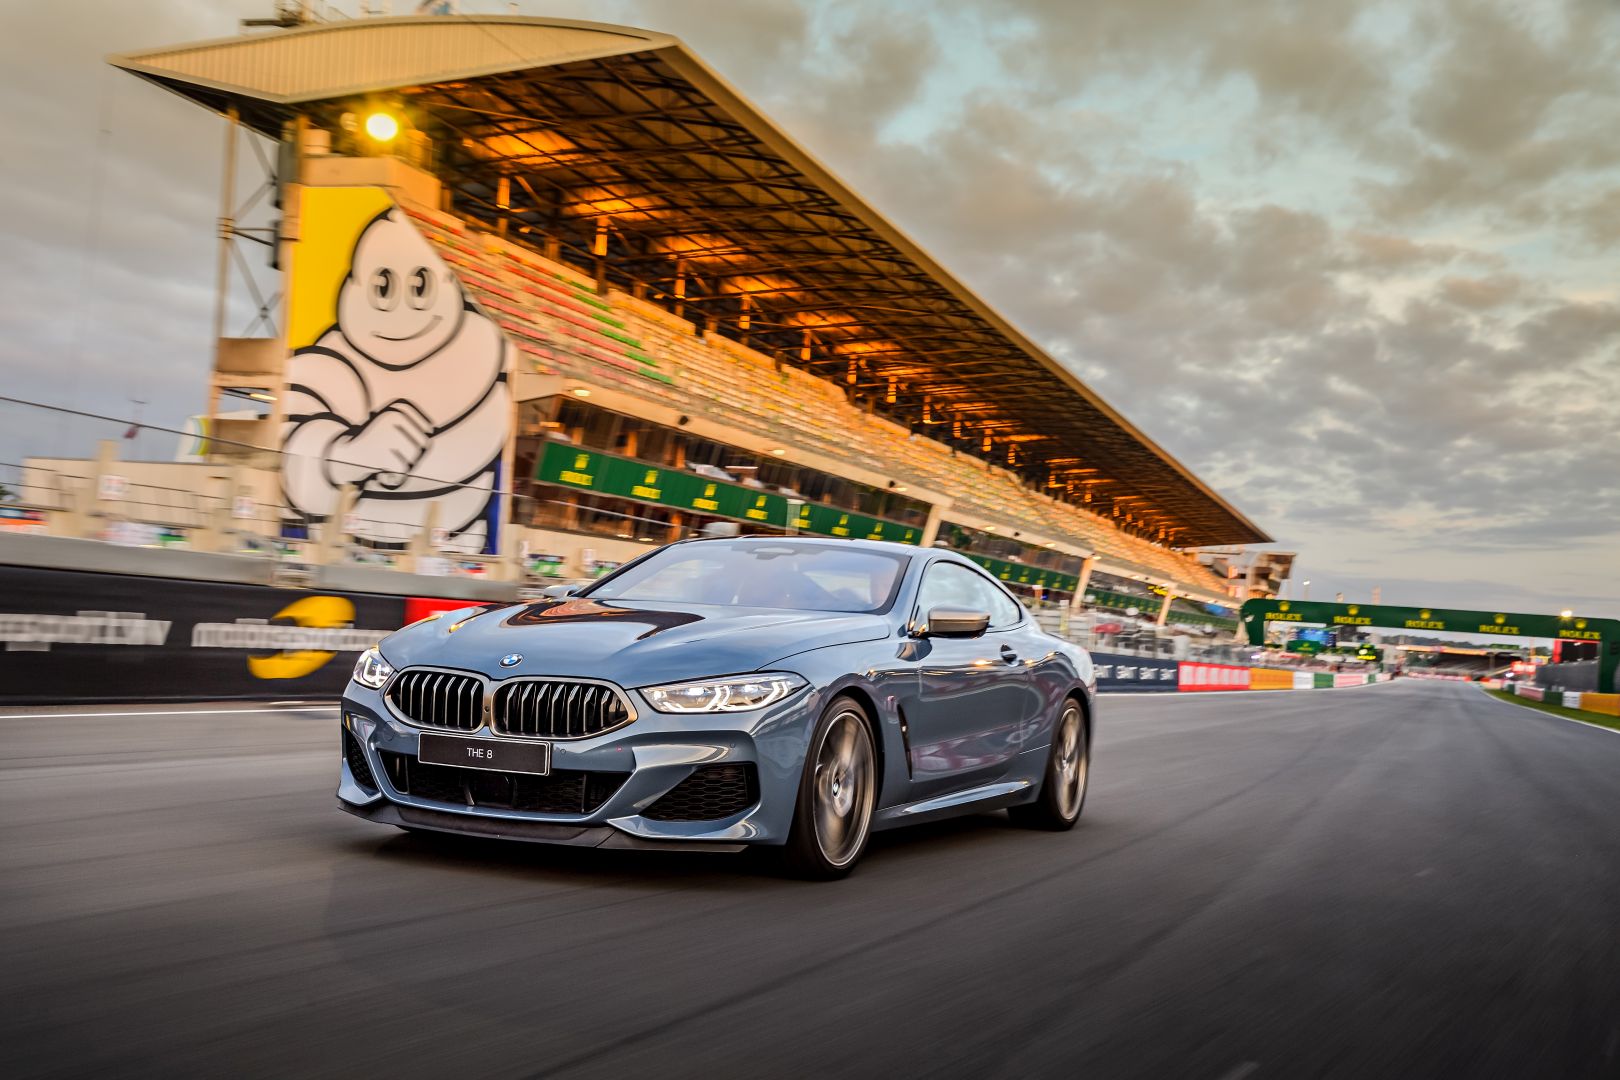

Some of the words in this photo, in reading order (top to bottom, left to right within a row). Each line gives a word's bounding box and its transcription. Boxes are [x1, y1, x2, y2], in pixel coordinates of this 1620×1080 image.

[1479, 625, 1520, 634] ROLEX
[1559, 630, 1601, 639] ROLEX
[467, 748, 484, 758] THE
[486, 750, 492, 758] 8
